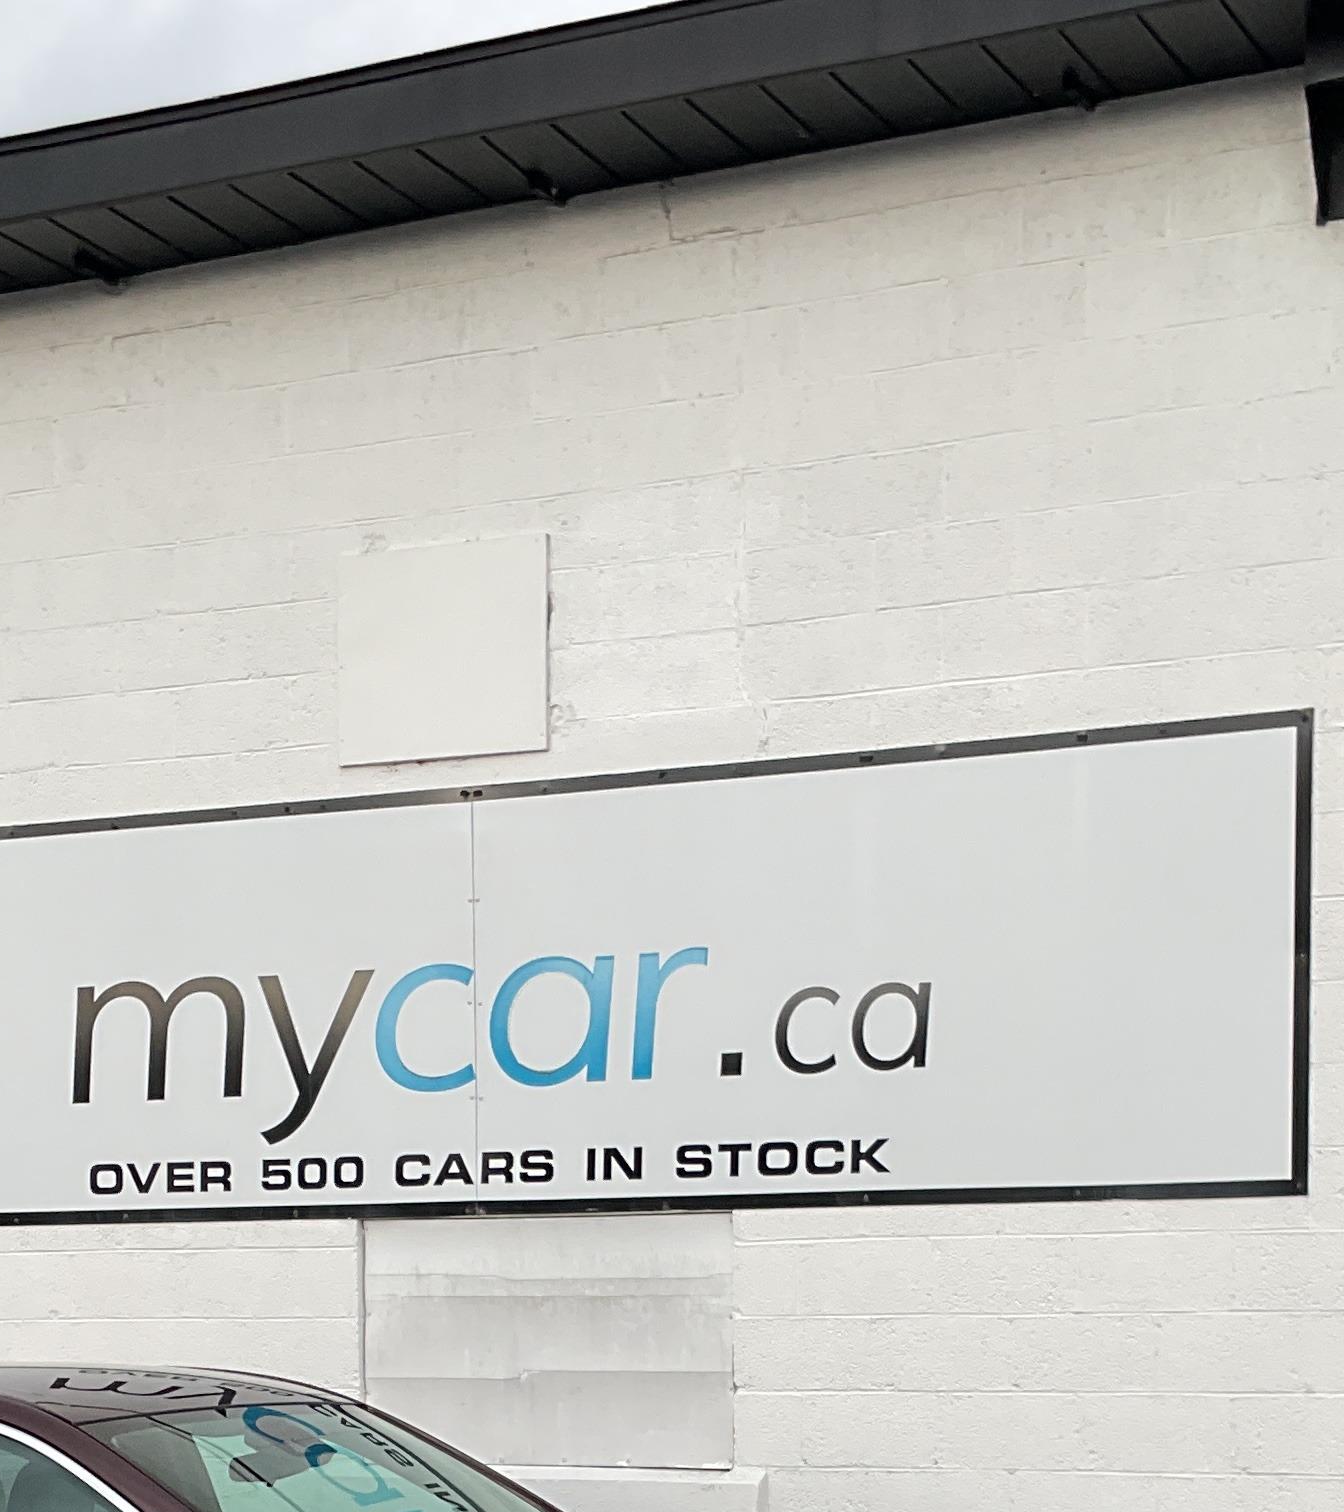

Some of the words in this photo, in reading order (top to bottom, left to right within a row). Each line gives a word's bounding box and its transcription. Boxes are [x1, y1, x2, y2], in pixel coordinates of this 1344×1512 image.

[89, 1161, 233, 1195] OVER
[260, 1155, 365, 1192] 500
[393, 1148, 555, 1188] CARS
[584, 1145, 646, 1182] IN
[673, 1137, 892, 1180] STOCK
